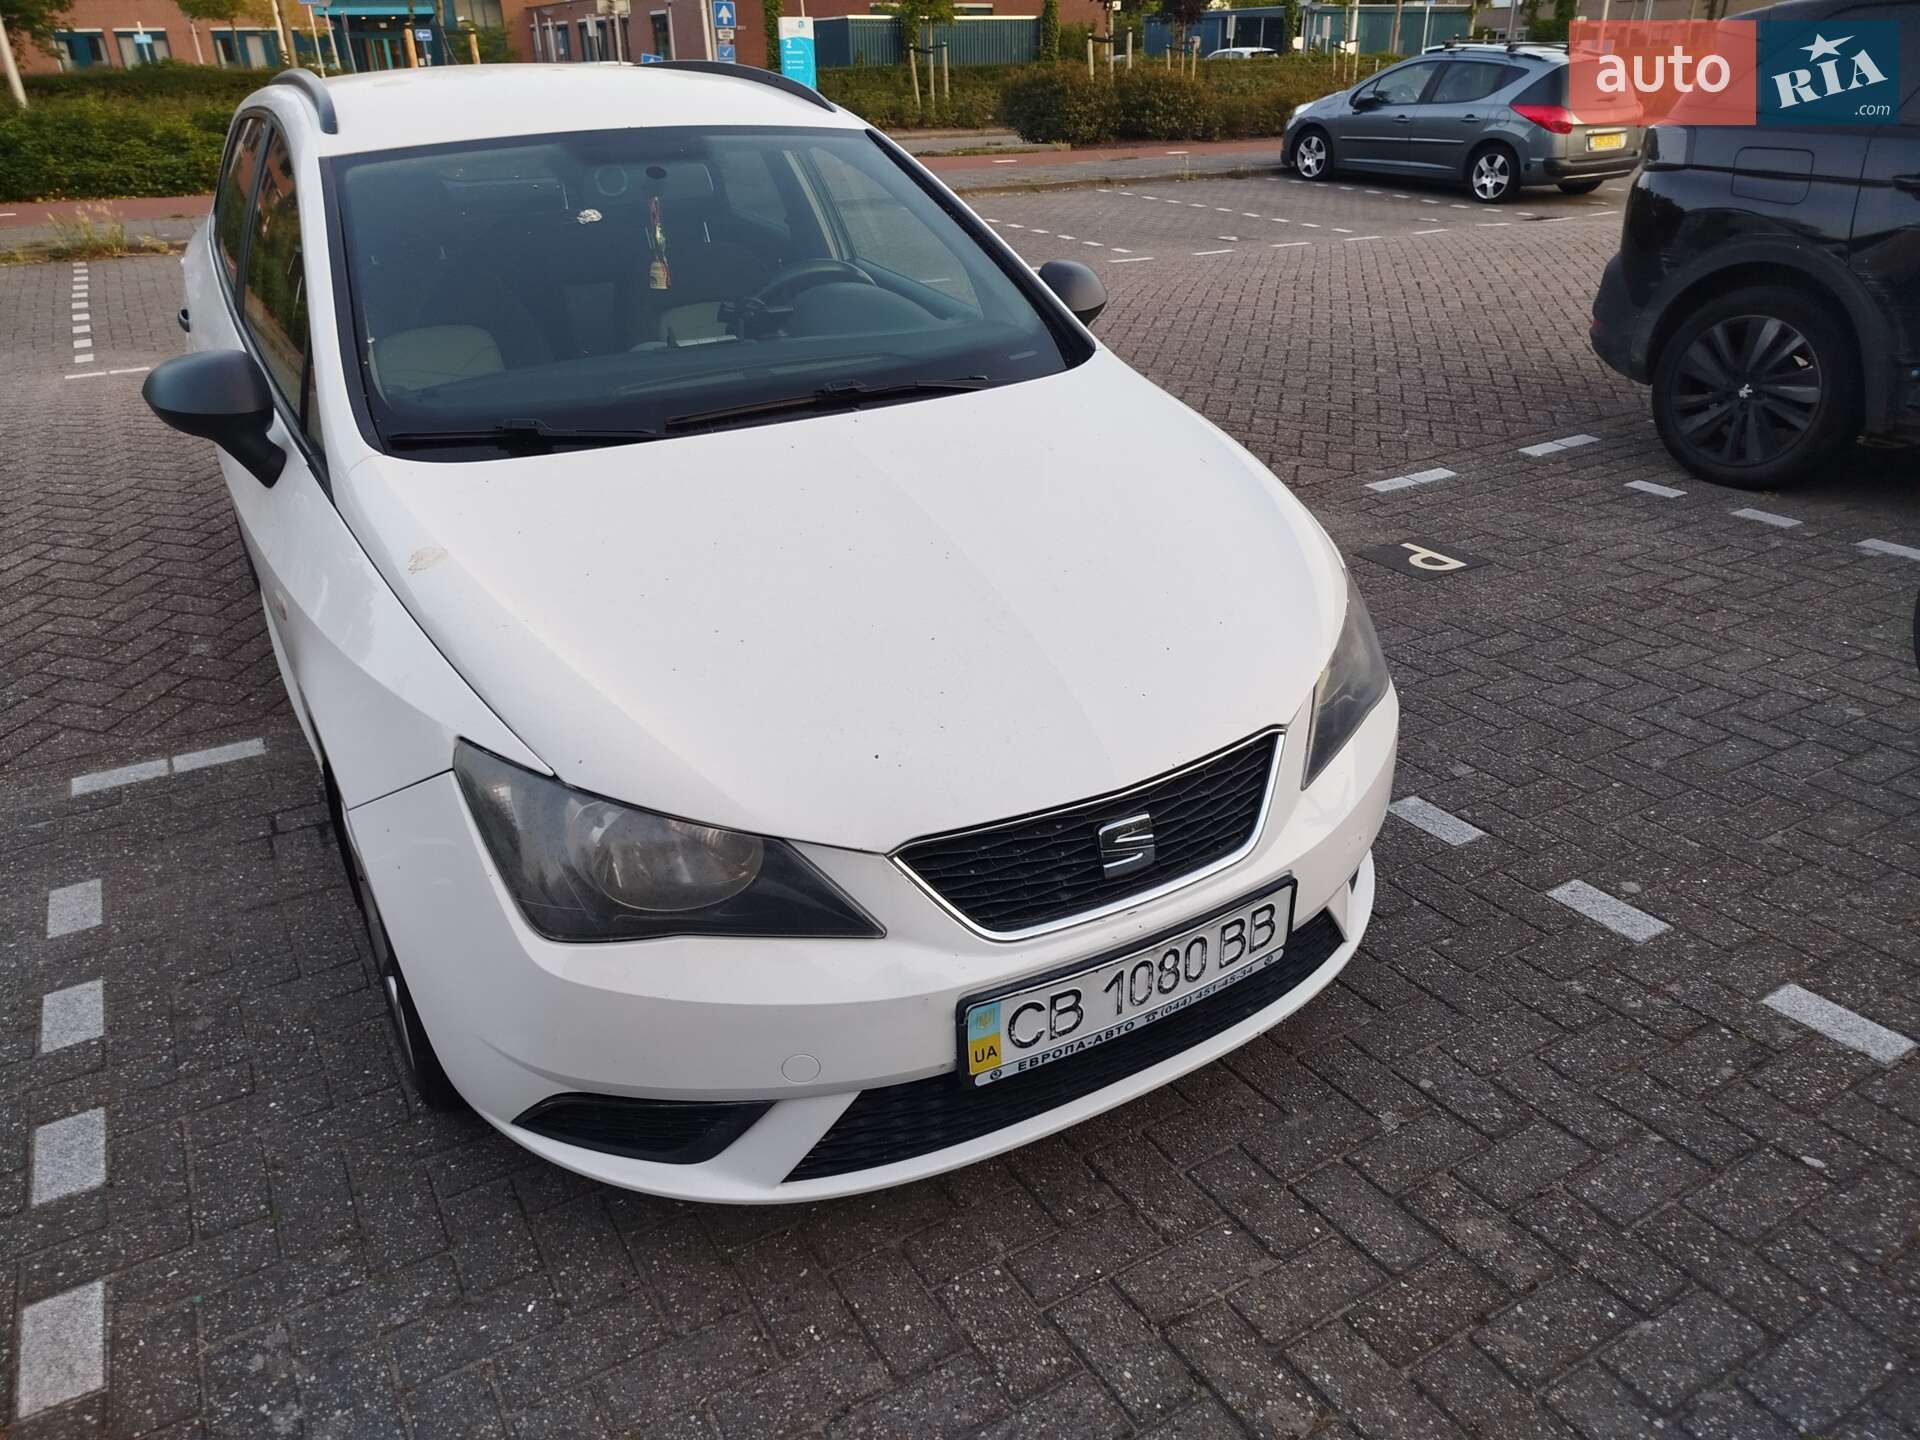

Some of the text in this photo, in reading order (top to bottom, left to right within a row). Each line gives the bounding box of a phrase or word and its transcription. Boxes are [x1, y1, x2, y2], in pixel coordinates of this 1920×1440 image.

[1007, 902, 1276, 1049] CB 1080 BB
[975, 1045, 998, 1063] UA
[1017, 1022, 1135, 1071] ЕВРОПА-АВТО
